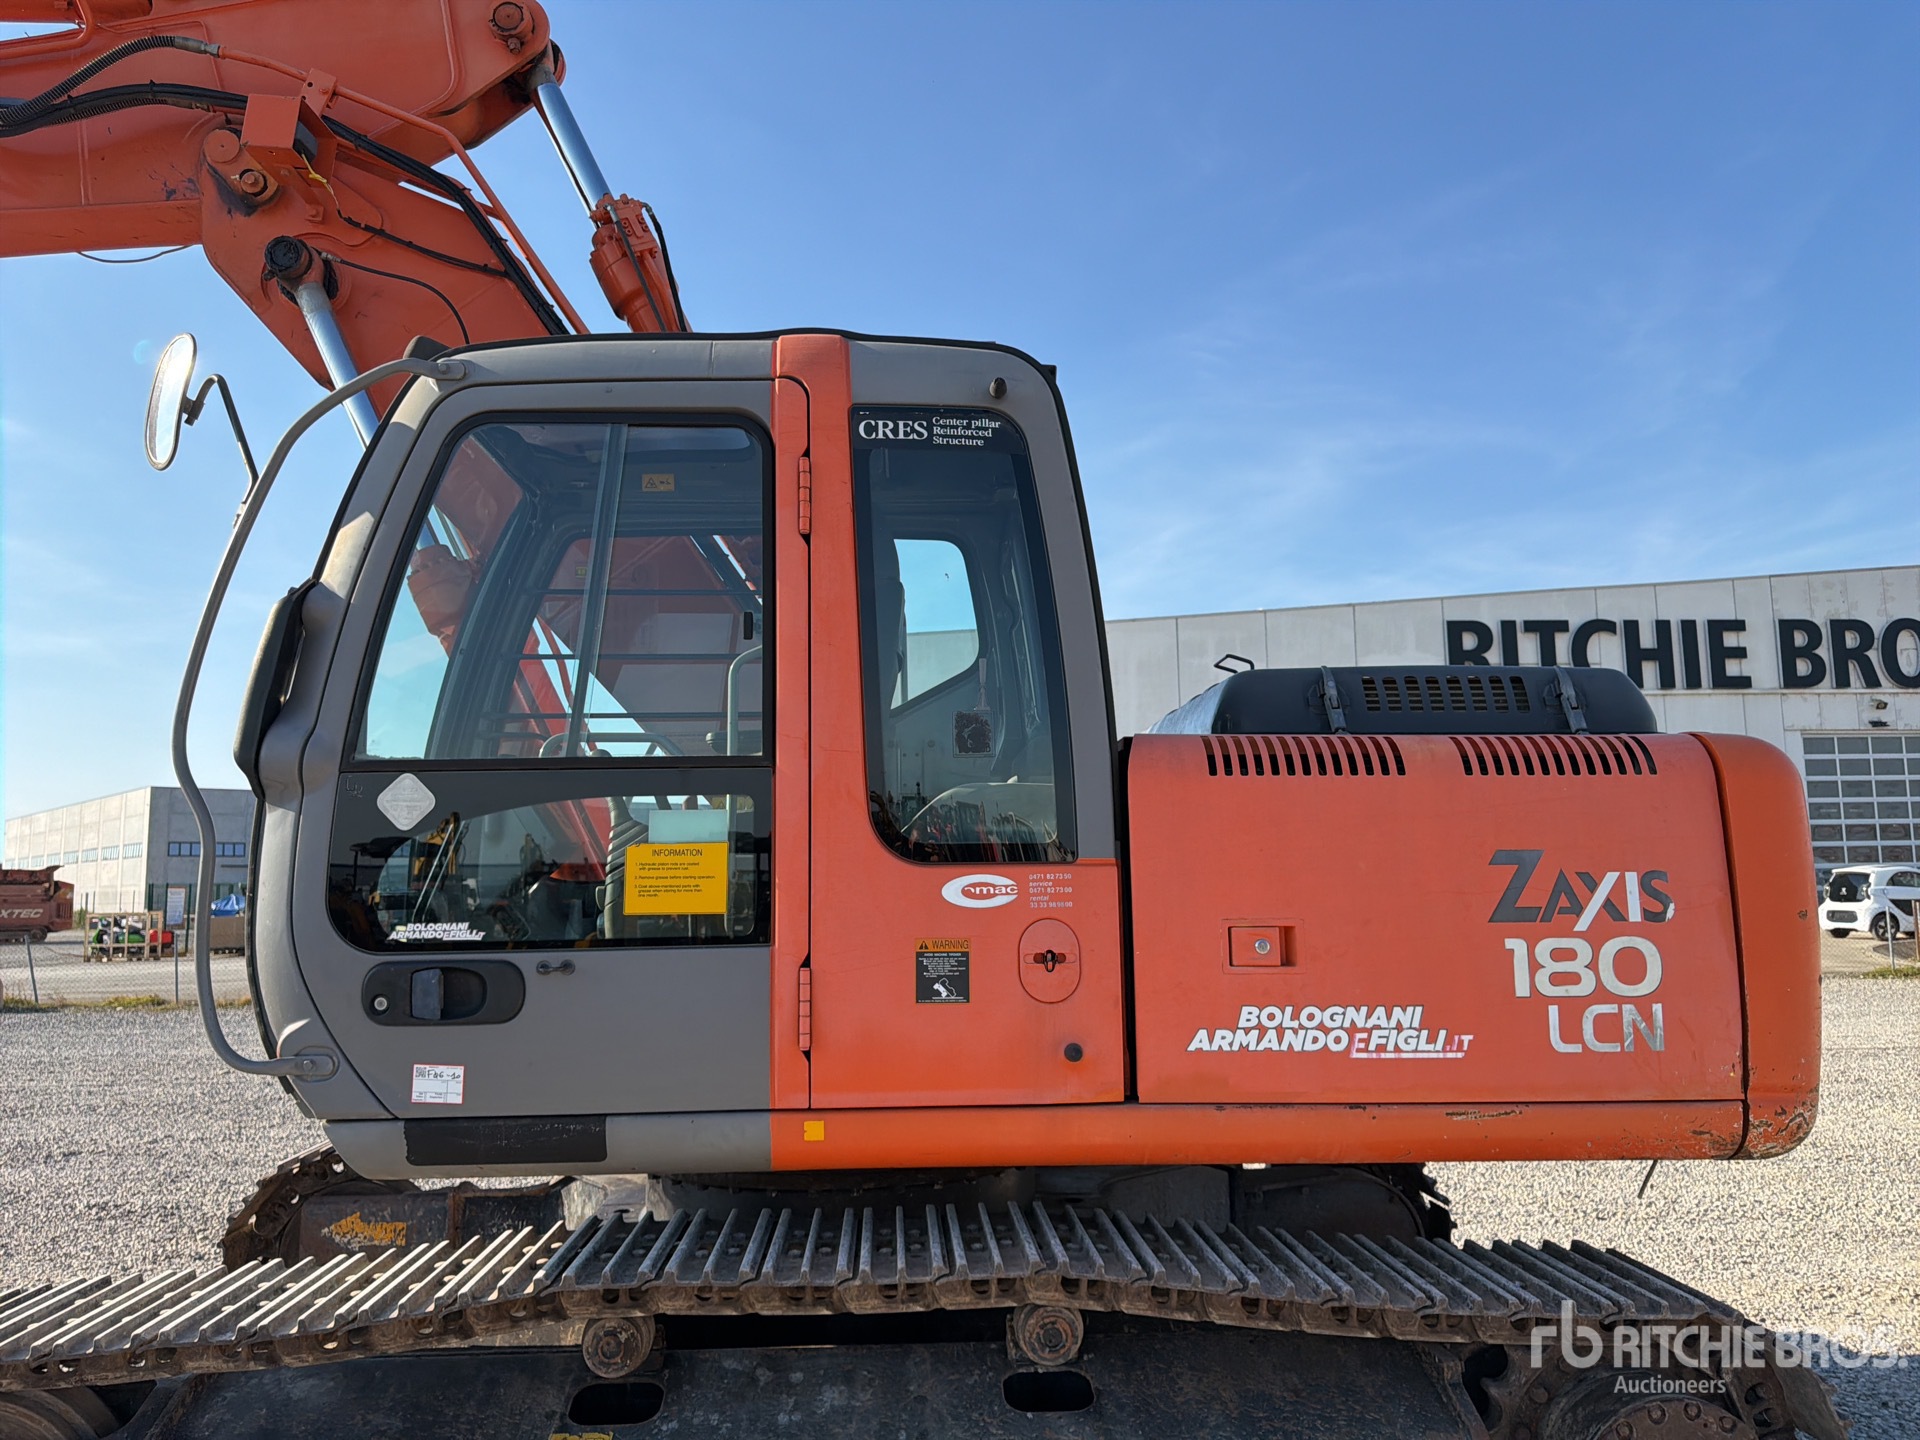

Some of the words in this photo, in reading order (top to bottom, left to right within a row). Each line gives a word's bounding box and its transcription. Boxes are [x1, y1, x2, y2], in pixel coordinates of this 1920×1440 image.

[858, 419, 929, 440] CRES
[932, 416, 969, 427] Center
[971, 418, 1001, 429] pillar
[932, 426, 993, 438] Reinforced
[932, 435, 985, 447] Structure
[1446, 618, 1753, 689] RITCHIE
[651, 848, 703, 857] INFORMATION
[1488, 849, 1676, 931] ZAXIS
[406, 921, 470, 931] BOLOGNANI
[931, 939, 969, 950] WARNING
[1504, 936, 1663, 998] 180
[1237, 1004, 1424, 1029] BOLOGNANI
[1548, 1002, 1665, 1053] LCN
